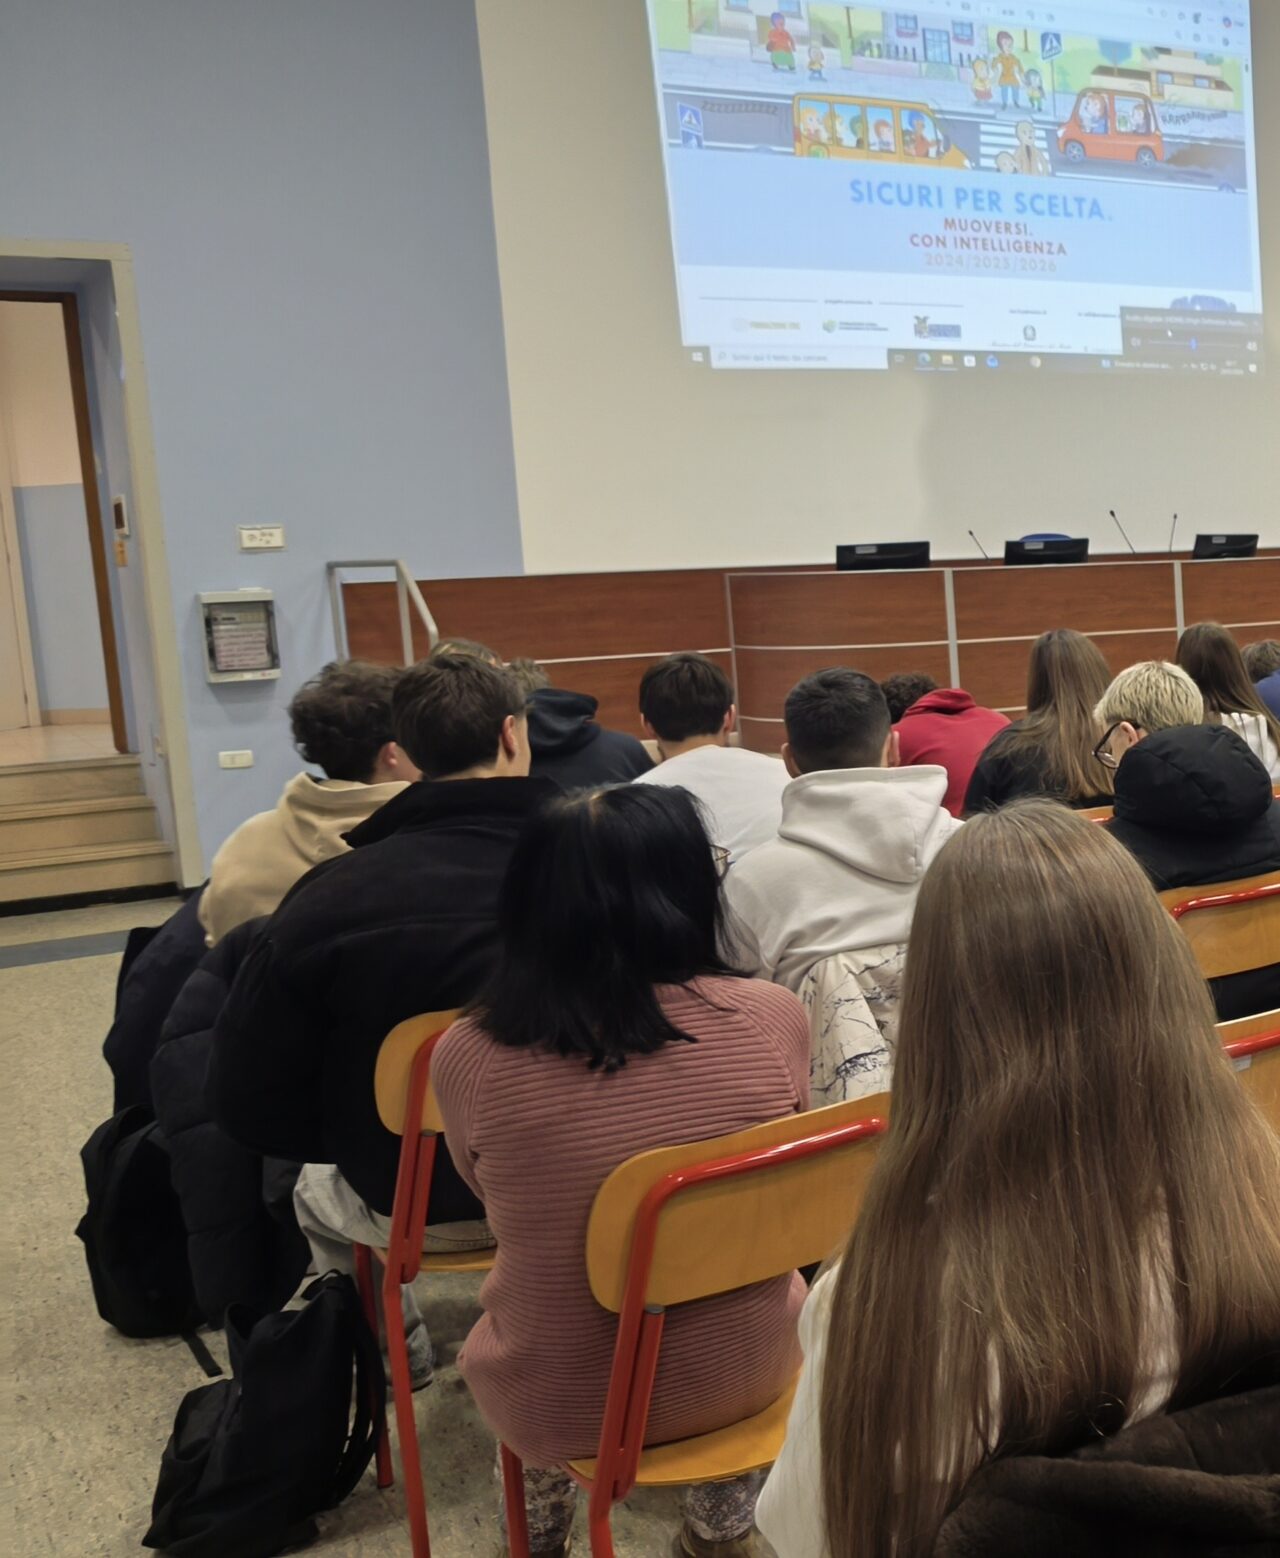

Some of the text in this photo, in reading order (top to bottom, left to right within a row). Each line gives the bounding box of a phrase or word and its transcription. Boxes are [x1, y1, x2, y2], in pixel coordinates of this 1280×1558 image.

[850, 180, 1113, 220] SICURI PER SCELTA.
[944, 218, 1033, 237] MUOVERSI.
[910, 234, 1067, 256] CON INTELLIGENZA
